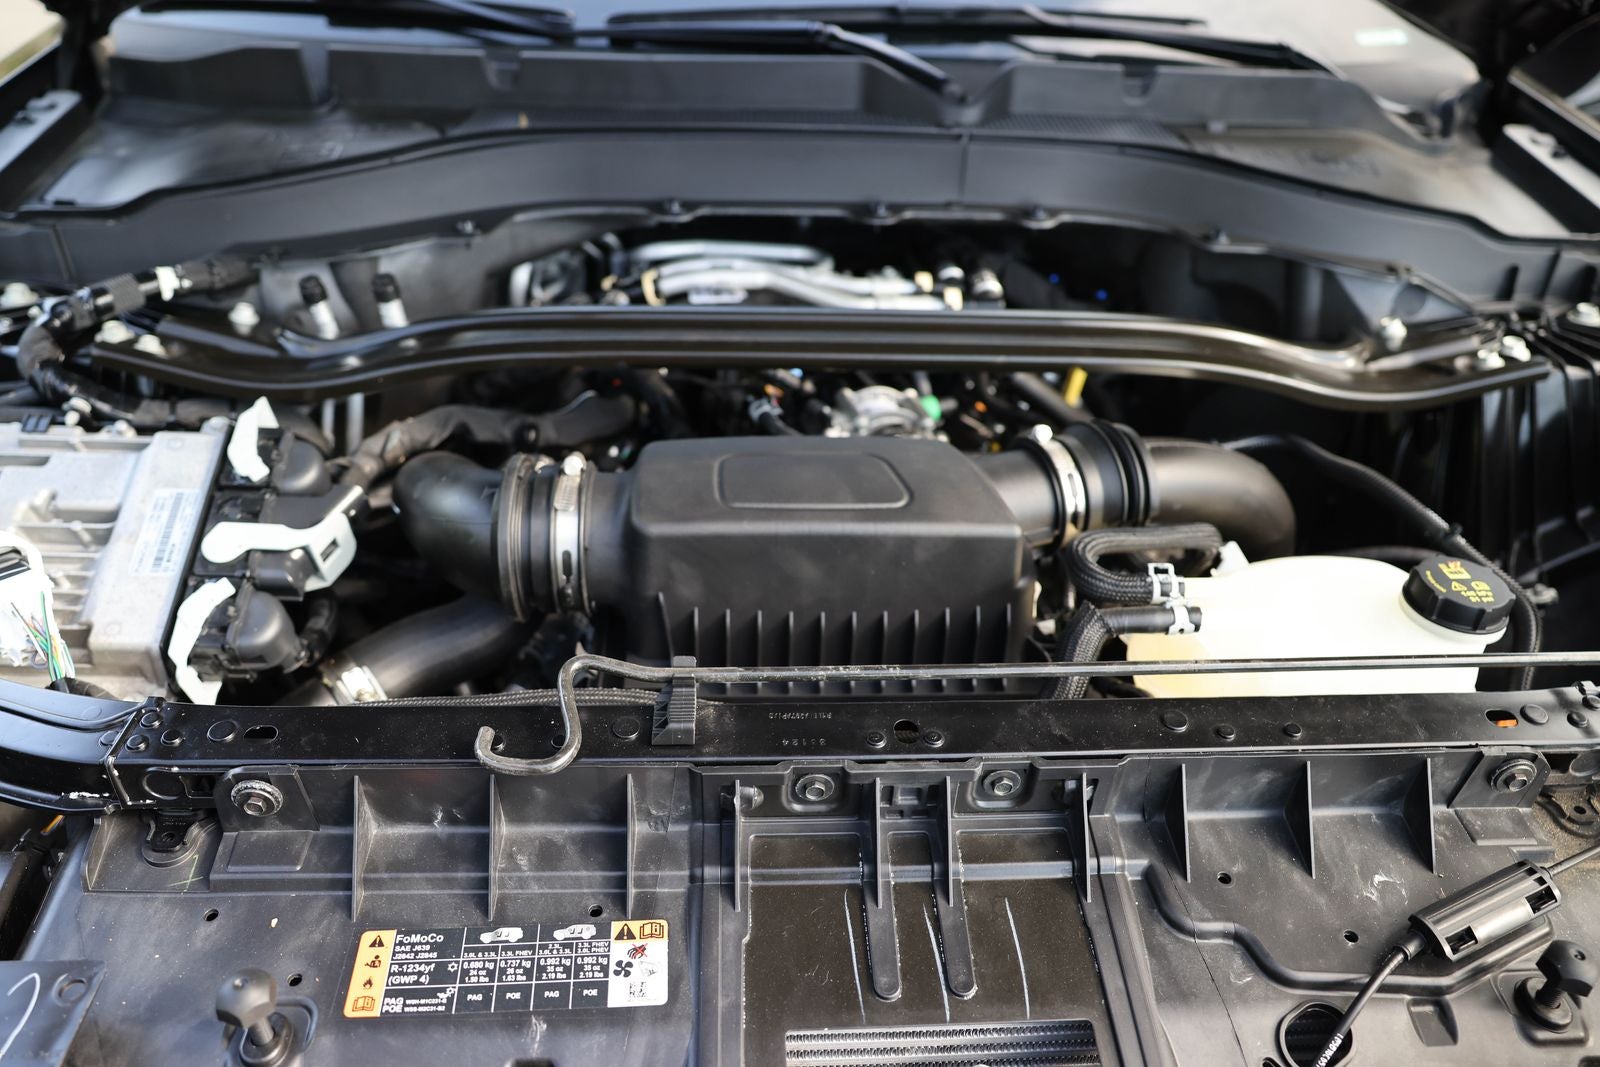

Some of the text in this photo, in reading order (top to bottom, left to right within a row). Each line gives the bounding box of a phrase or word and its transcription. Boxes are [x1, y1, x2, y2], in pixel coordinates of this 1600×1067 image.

[396, 933, 444, 944] FoMoCo
[500, 959, 531, 968] 0.737 kg
[540, 957, 571, 966] 0.992 kg
[577, 956, 608, 965] 0.992 kg
[390, 963, 435, 973] R-1234yf
[463, 961, 494, 970] 0.680 kg
[388, 975, 430, 986] (GWP 4)
[506, 992, 521, 1000] POE
[544, 990, 560, 998] PAG
[583, 989, 598, 997] POE
[384, 997, 404, 1005] PAG
[382, 1005, 403, 1013] POE
